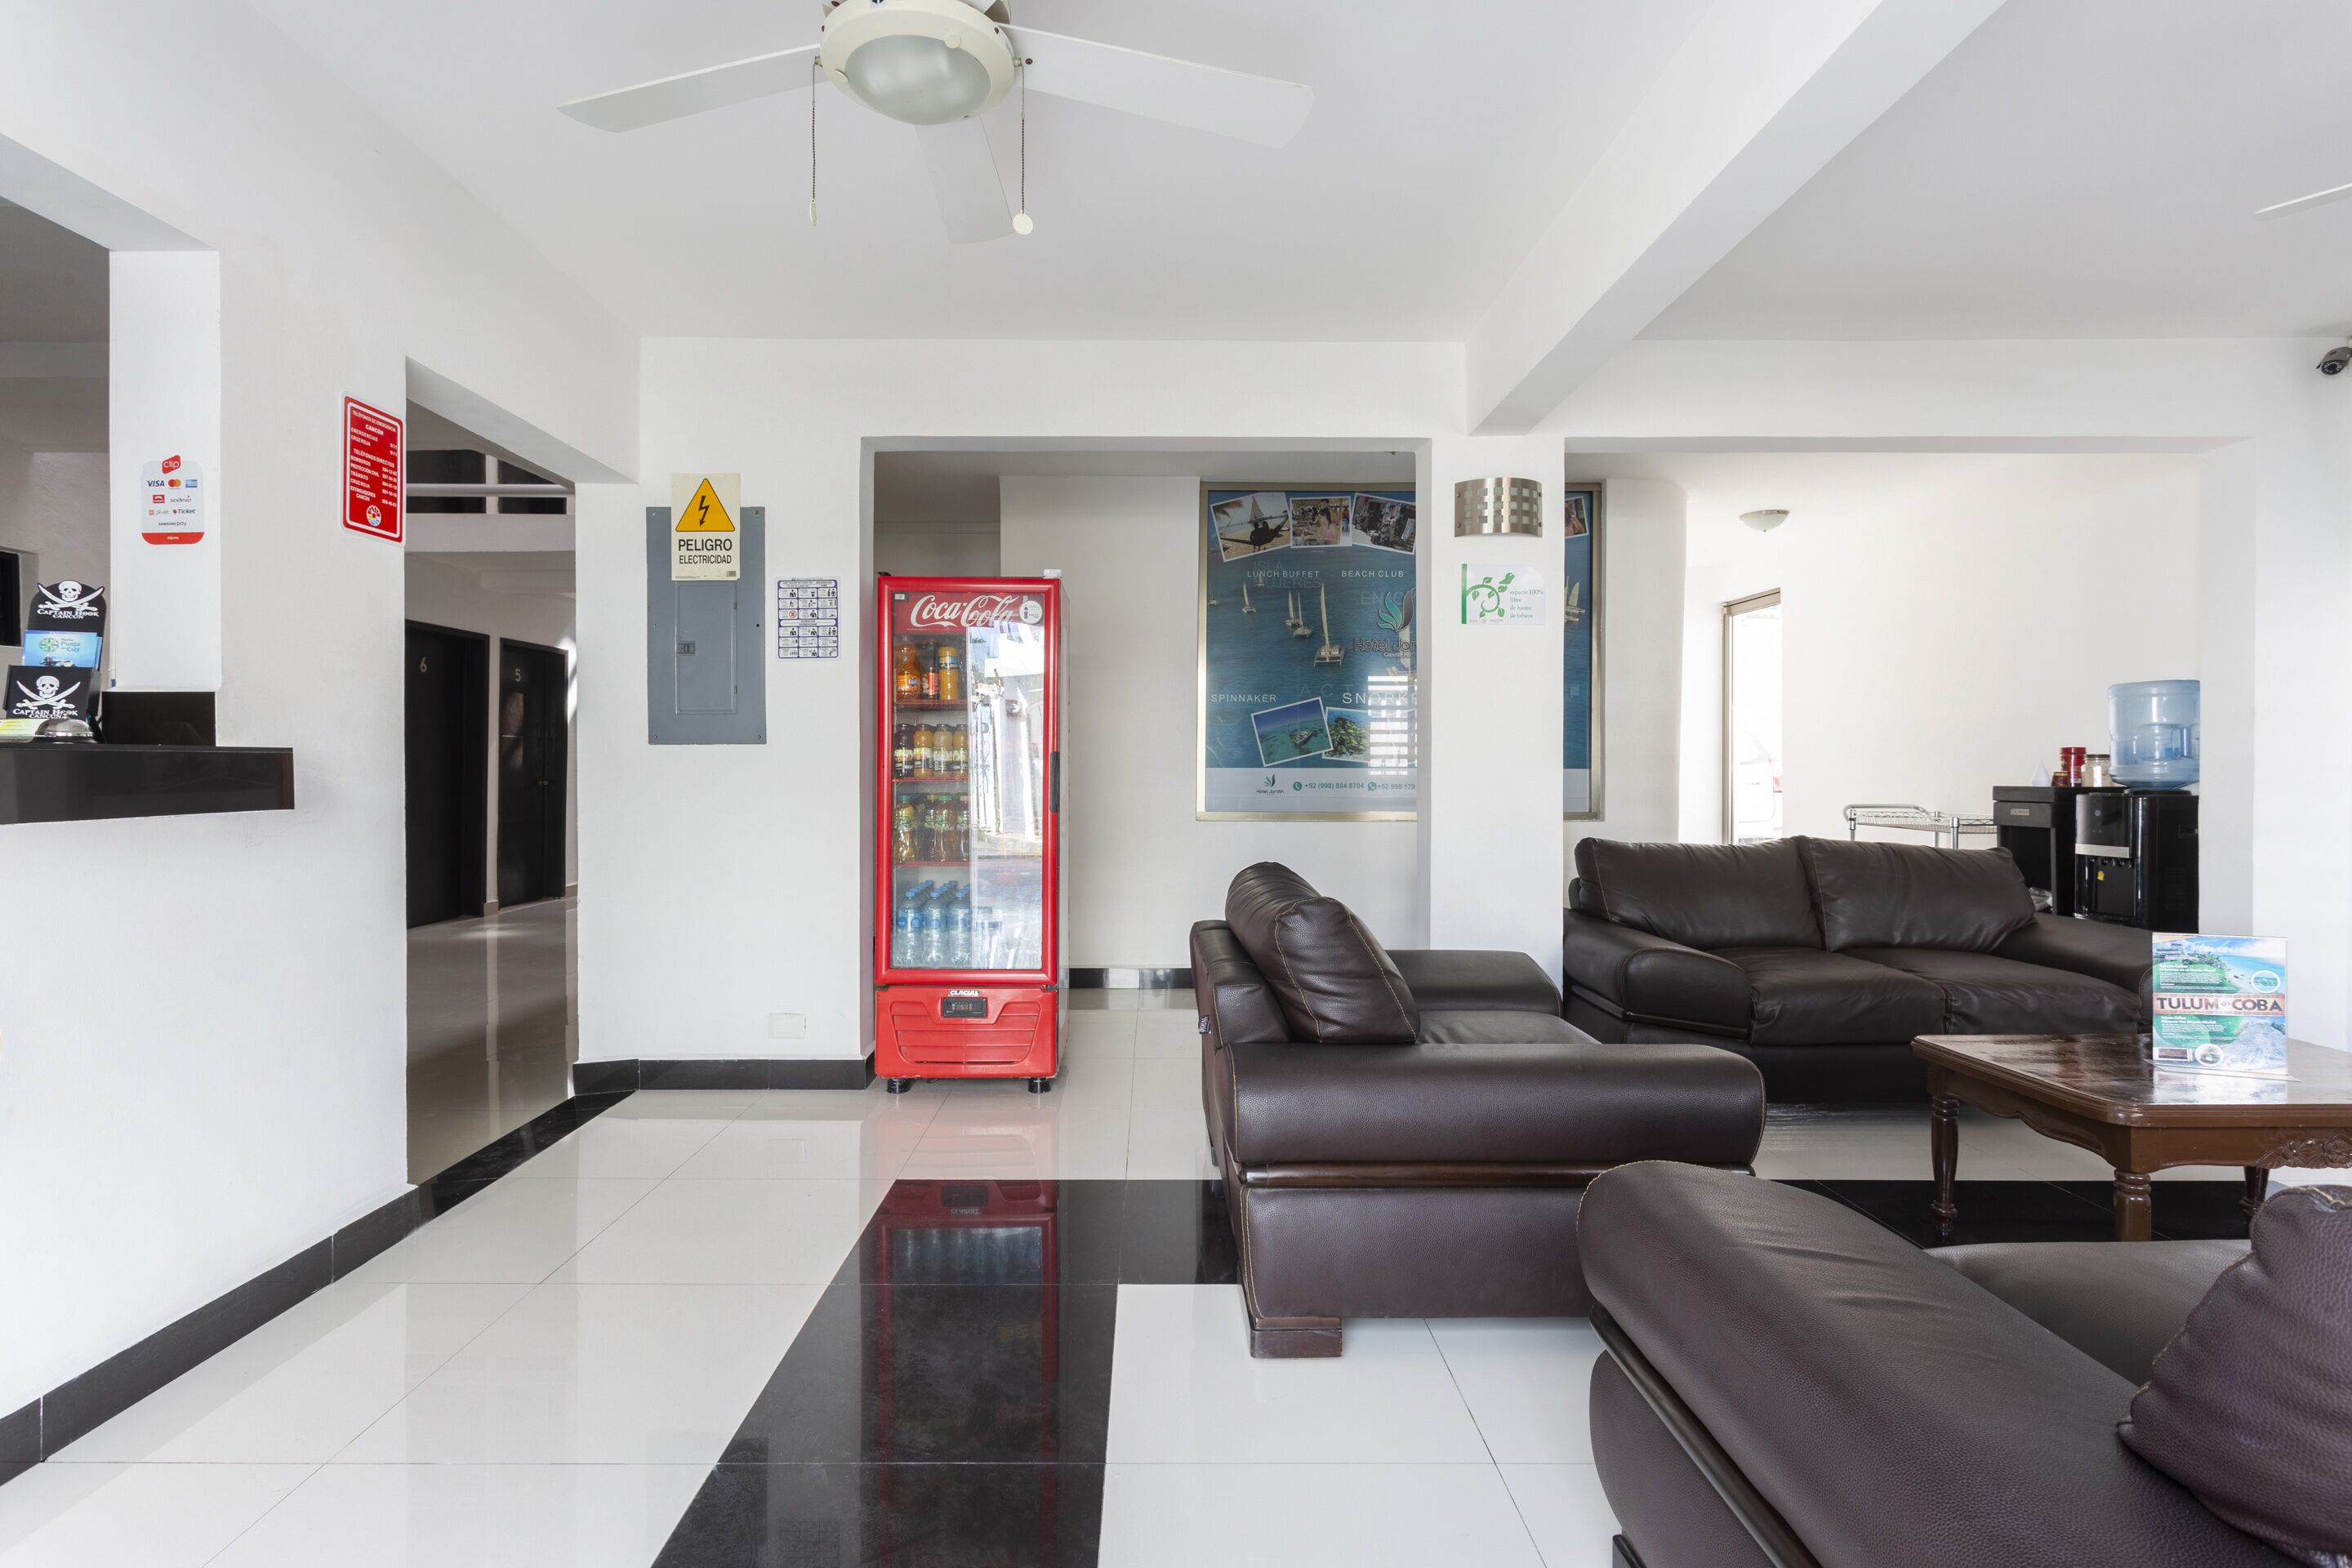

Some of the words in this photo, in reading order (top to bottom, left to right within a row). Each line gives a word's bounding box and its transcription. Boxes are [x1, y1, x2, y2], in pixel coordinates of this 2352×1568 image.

[678, 539, 732, 551] PELIGRO
[679, 555, 731, 564] ELECTRICIDAD
[911, 595, 1019, 628] Coca-Cola
[1354, 638, 1389, 652] Hotel
[420, 656, 427, 672] 6
[515, 668, 521, 682] 5
[1211, 694, 1276, 702] SPINNAKER
[2157, 998, 2218, 1010] TULUM
[2232, 999, 2283, 1011] COBA
